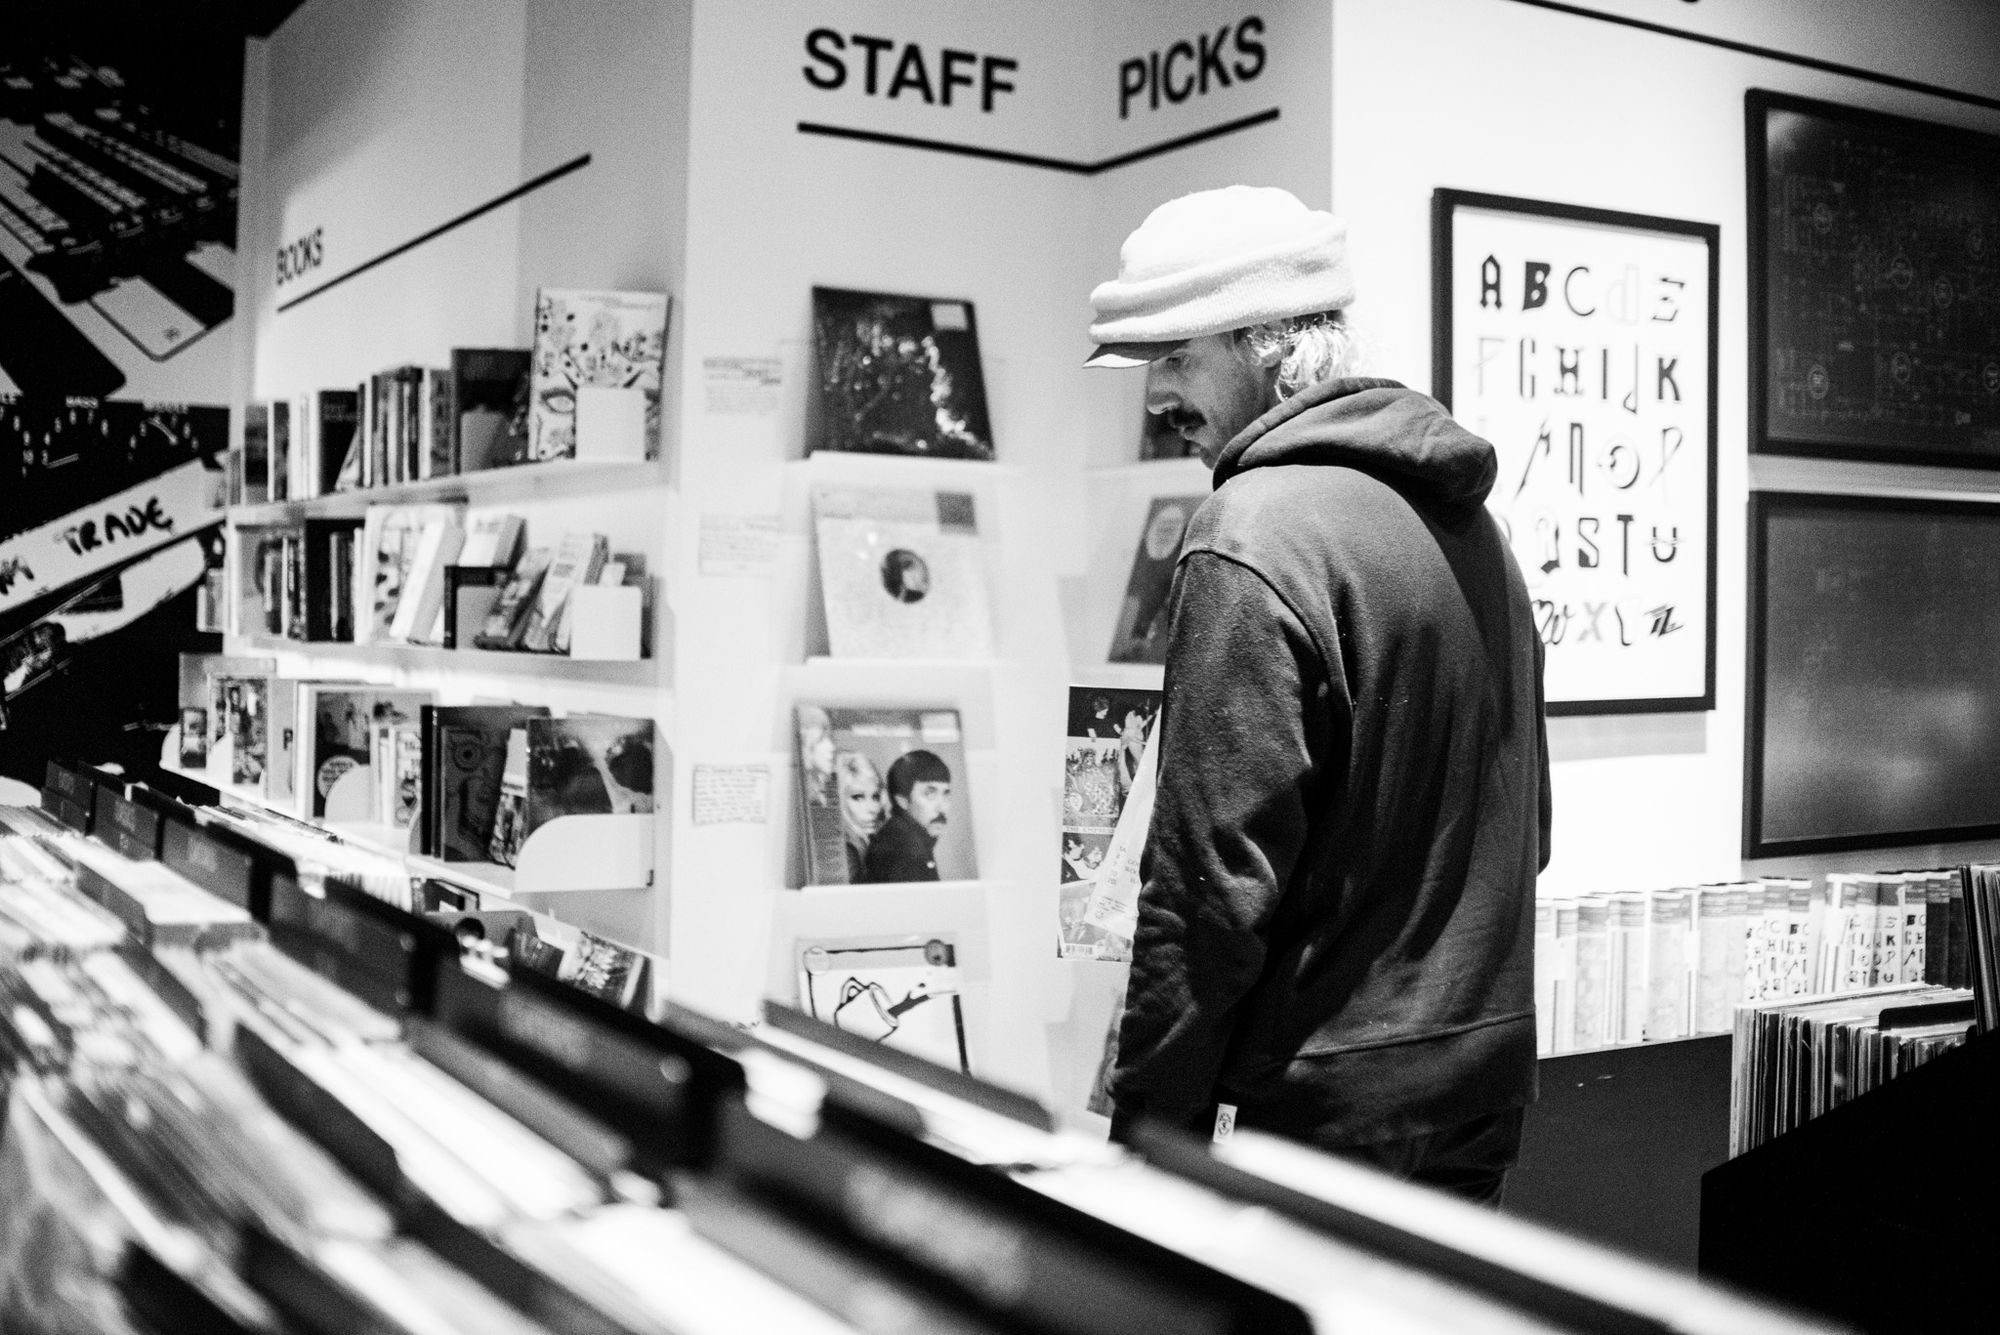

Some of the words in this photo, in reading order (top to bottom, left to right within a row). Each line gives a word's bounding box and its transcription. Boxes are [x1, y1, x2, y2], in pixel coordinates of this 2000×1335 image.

[802, 27, 1018, 112] STAFF
[1119, 16, 1267, 119] PICKS
[277, 229, 322, 285] BOOKS
[1480, 254, 1502, 309] A
[1522, 261, 1551, 311] B
[1565, 265, 1595, 317] C
[1553, 345, 1584, 396] H
[1658, 357, 1681, 401] K
[64, 497, 174, 556] TRADE
[1577, 516, 1600, 569] S
[1616, 514, 1635, 577] T
